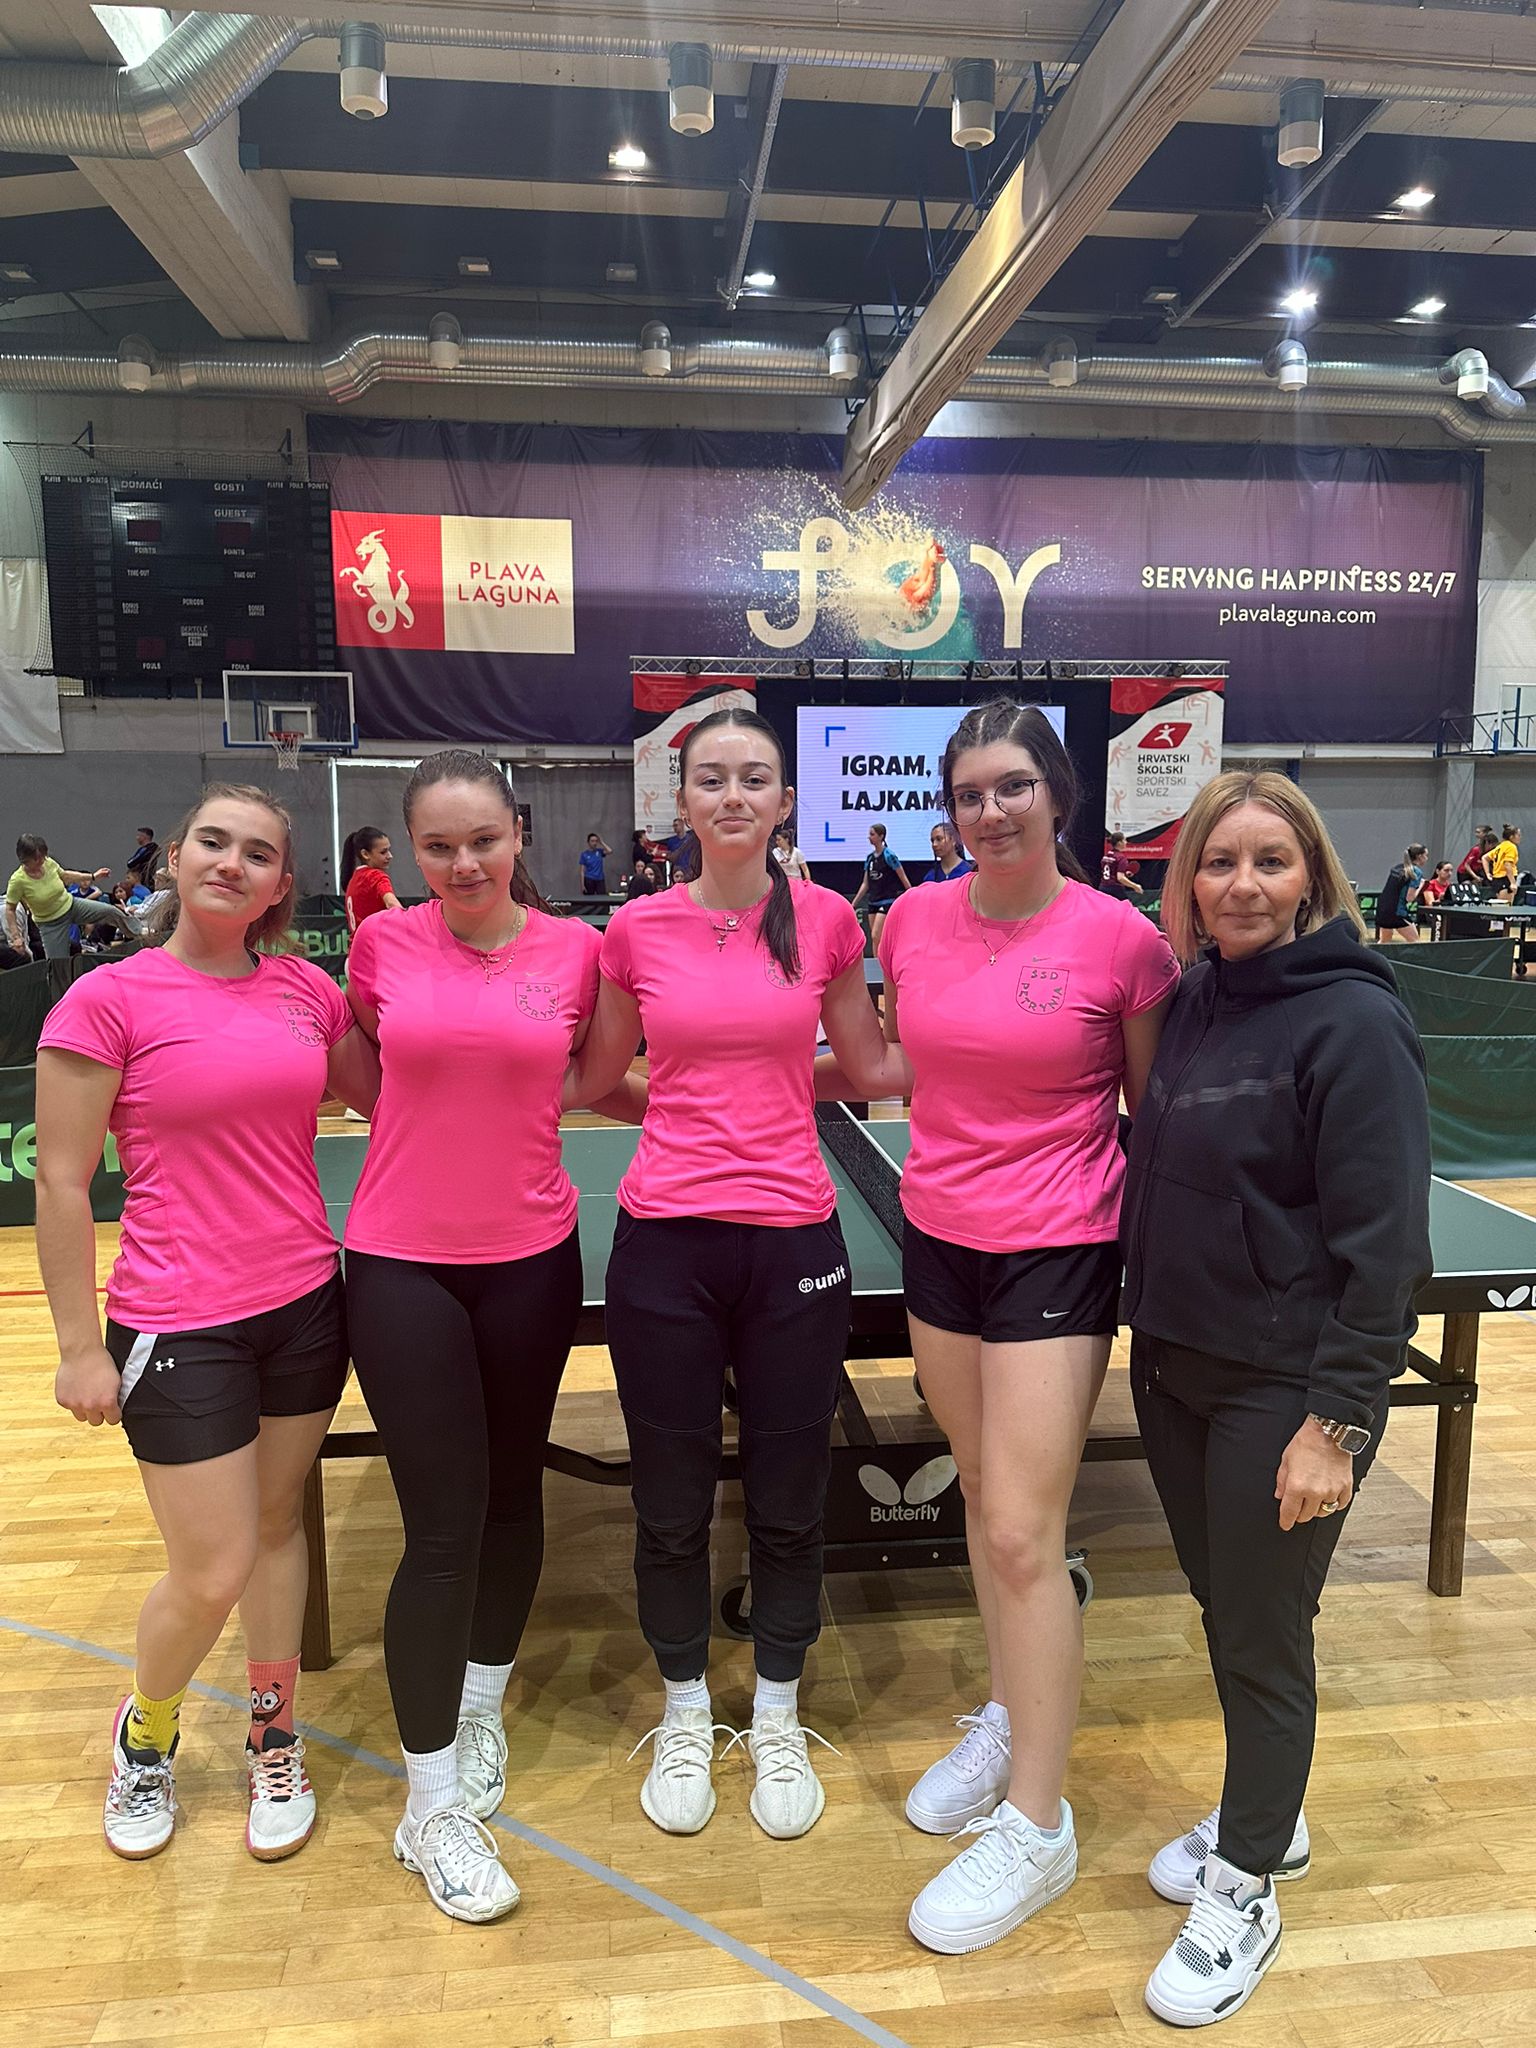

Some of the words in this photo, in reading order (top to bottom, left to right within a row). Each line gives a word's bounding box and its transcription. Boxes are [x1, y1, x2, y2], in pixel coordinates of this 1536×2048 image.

[121, 479, 163, 490] DOMAĆI
[213, 483, 245, 492] GOSTI
[214, 509, 247, 518] GUEST
[134, 546, 157, 554] POINTS
[223, 548, 245, 556] POINTS
[470, 562, 545, 581] PLAVA
[1141, 565, 1254, 590] SERVING
[1261, 565, 1402, 593] HAPPINESS
[1407, 570, 1457, 599] 24/7
[458, 584, 559, 607] LAGUNA
[1219, 603, 1376, 627] plavalaguna.com
[142, 662, 161, 670] FOULS
[231, 663, 250, 671] FOULS
[1137, 754, 1190, 763] HRVATSKI
[841, 754, 932, 778] IGRAM,
[1137, 764, 1183, 775] ŠKOLSKI
[1136, 776, 1186, 786] SPORTSKI
[1136, 787, 1169, 797] SAVEZ
[1031, 969, 1059, 980] SSD
[526, 984, 551, 993] SSD
[815, 1264, 847, 1290] unit
[870, 1504, 940, 1522] Butterfly
